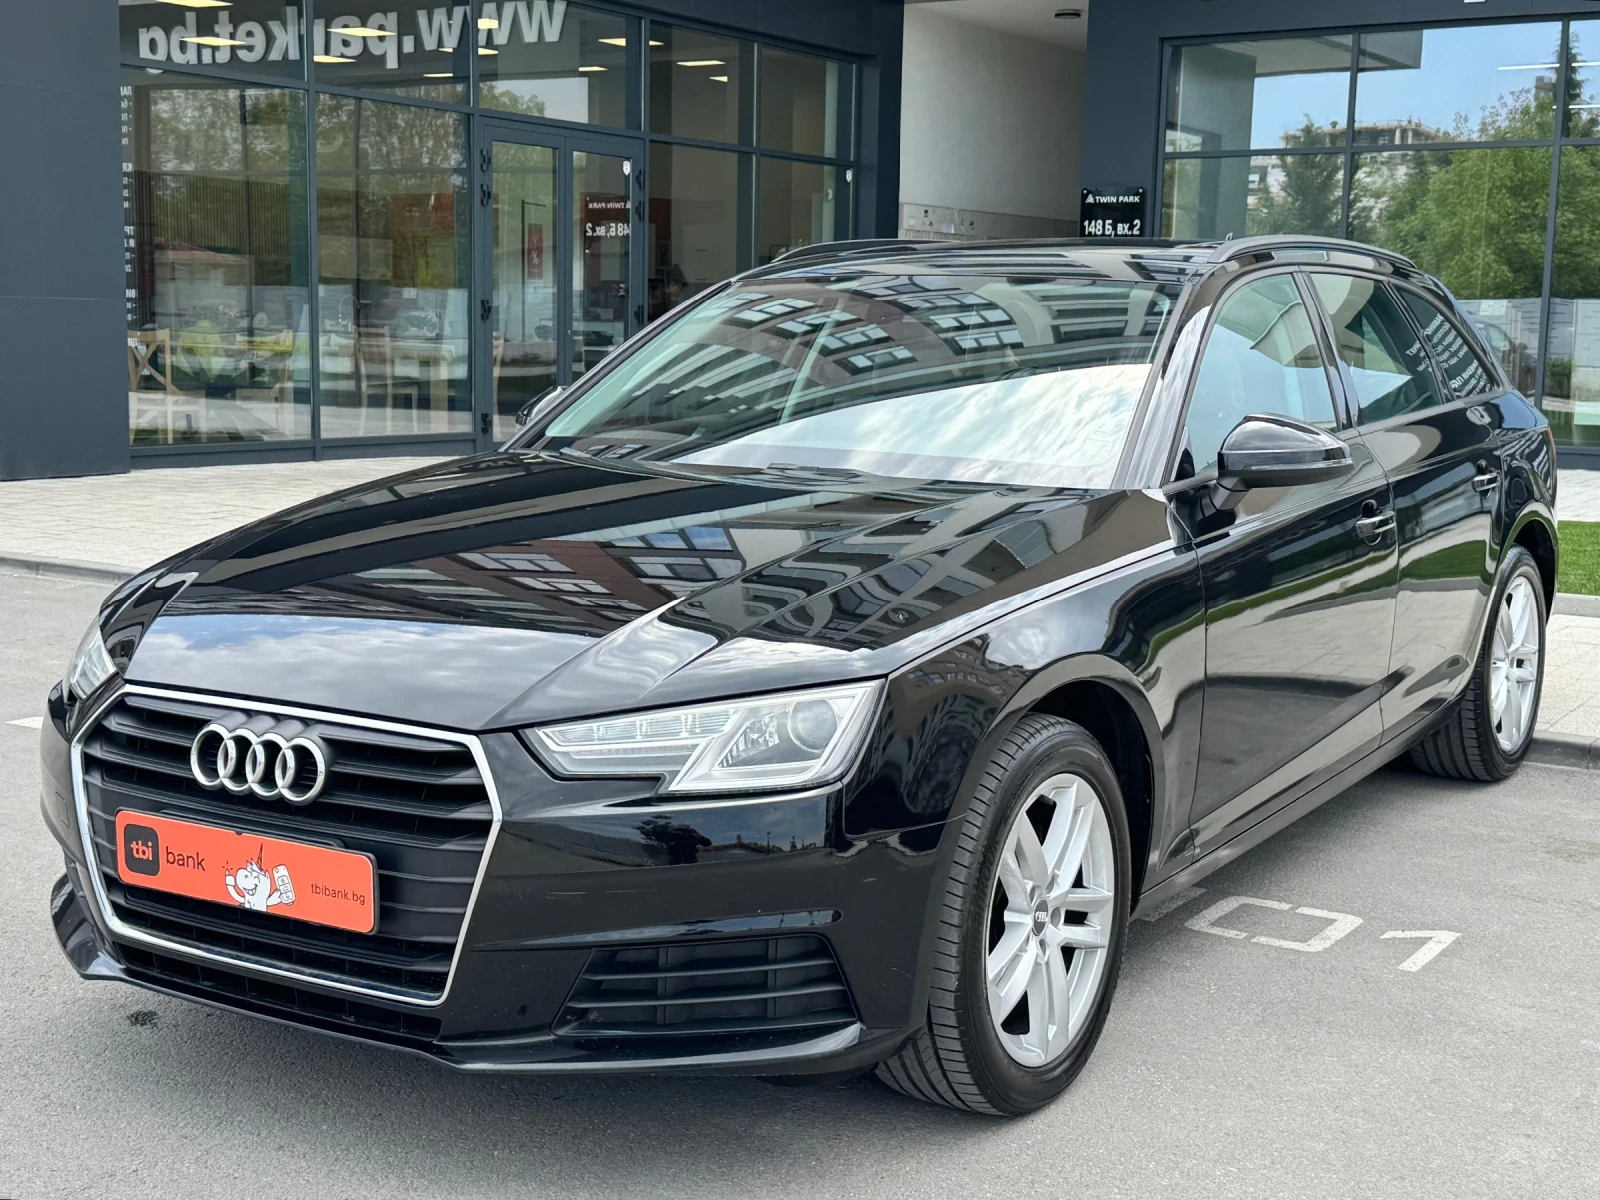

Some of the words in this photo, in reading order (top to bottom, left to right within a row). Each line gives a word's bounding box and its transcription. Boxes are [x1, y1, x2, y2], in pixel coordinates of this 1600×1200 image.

[1095, 195, 1117, 204] TWIN
[1118, 195, 1141, 203] PARK
[1083, 219, 1103, 236] 148
[131, 840, 153, 861] tbi
[165, 846, 206, 872] bank
[310, 882, 366, 906] tbibank.bg
